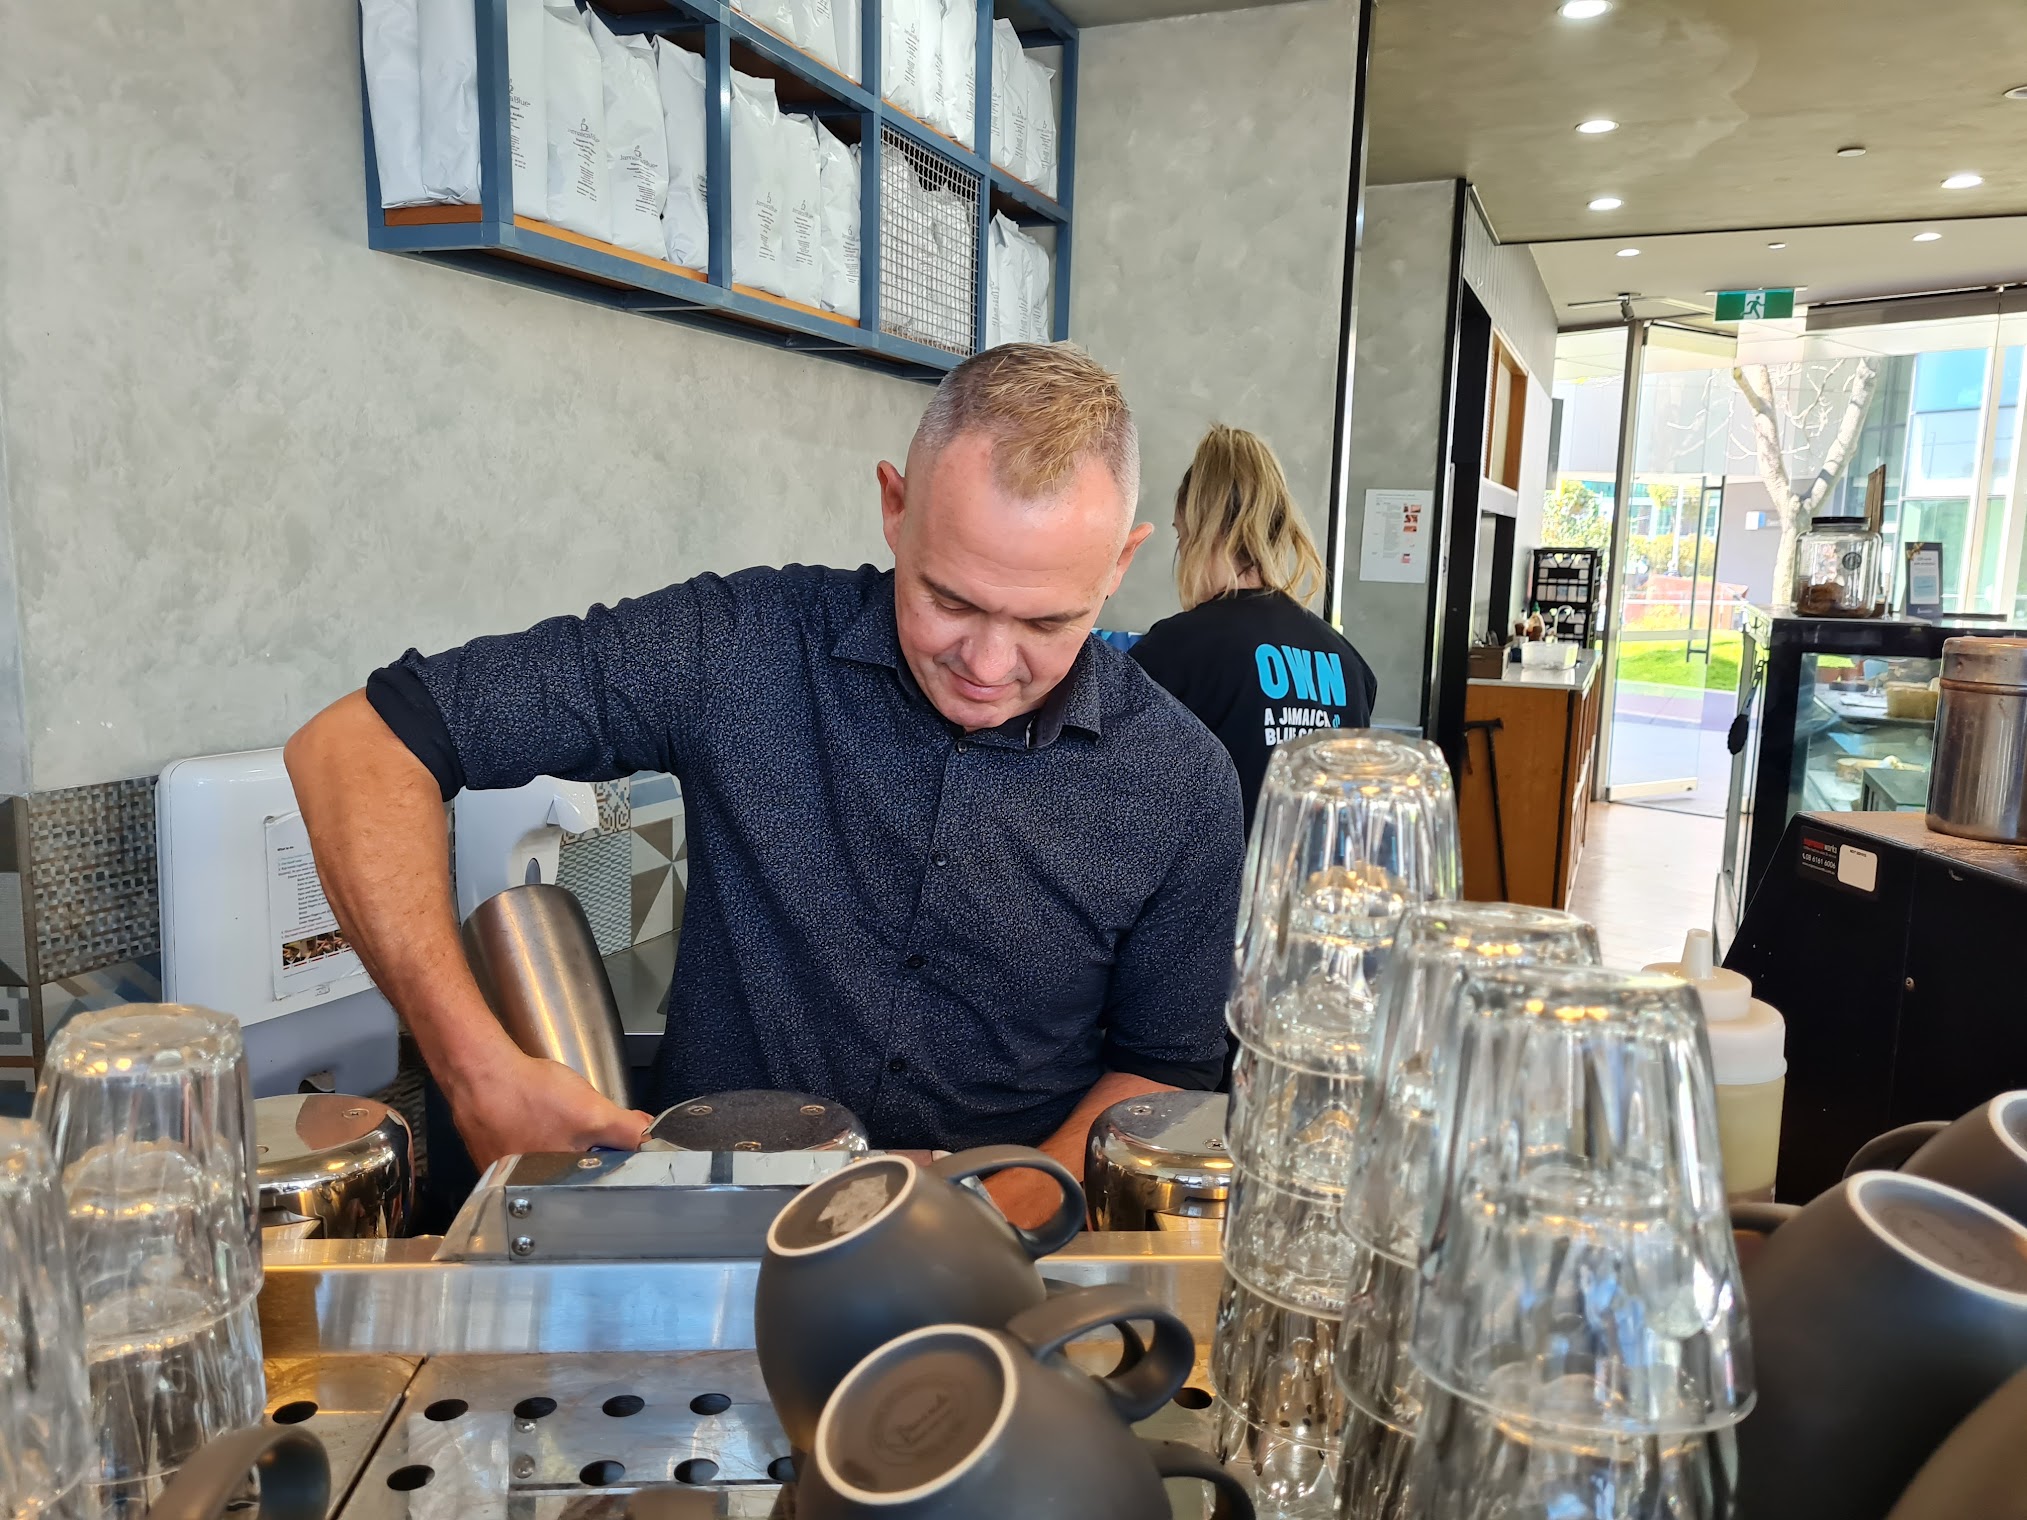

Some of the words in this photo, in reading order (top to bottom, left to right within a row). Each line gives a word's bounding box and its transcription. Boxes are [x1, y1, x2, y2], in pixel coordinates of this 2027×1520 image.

[1255, 643, 1346, 706] OWN
[1264, 707, 1275, 726] A
[1279, 706, 1332, 728] JAMAICA
[1812, 856, 1824, 865] 6161
[1824, 859, 1836, 869] 6006
